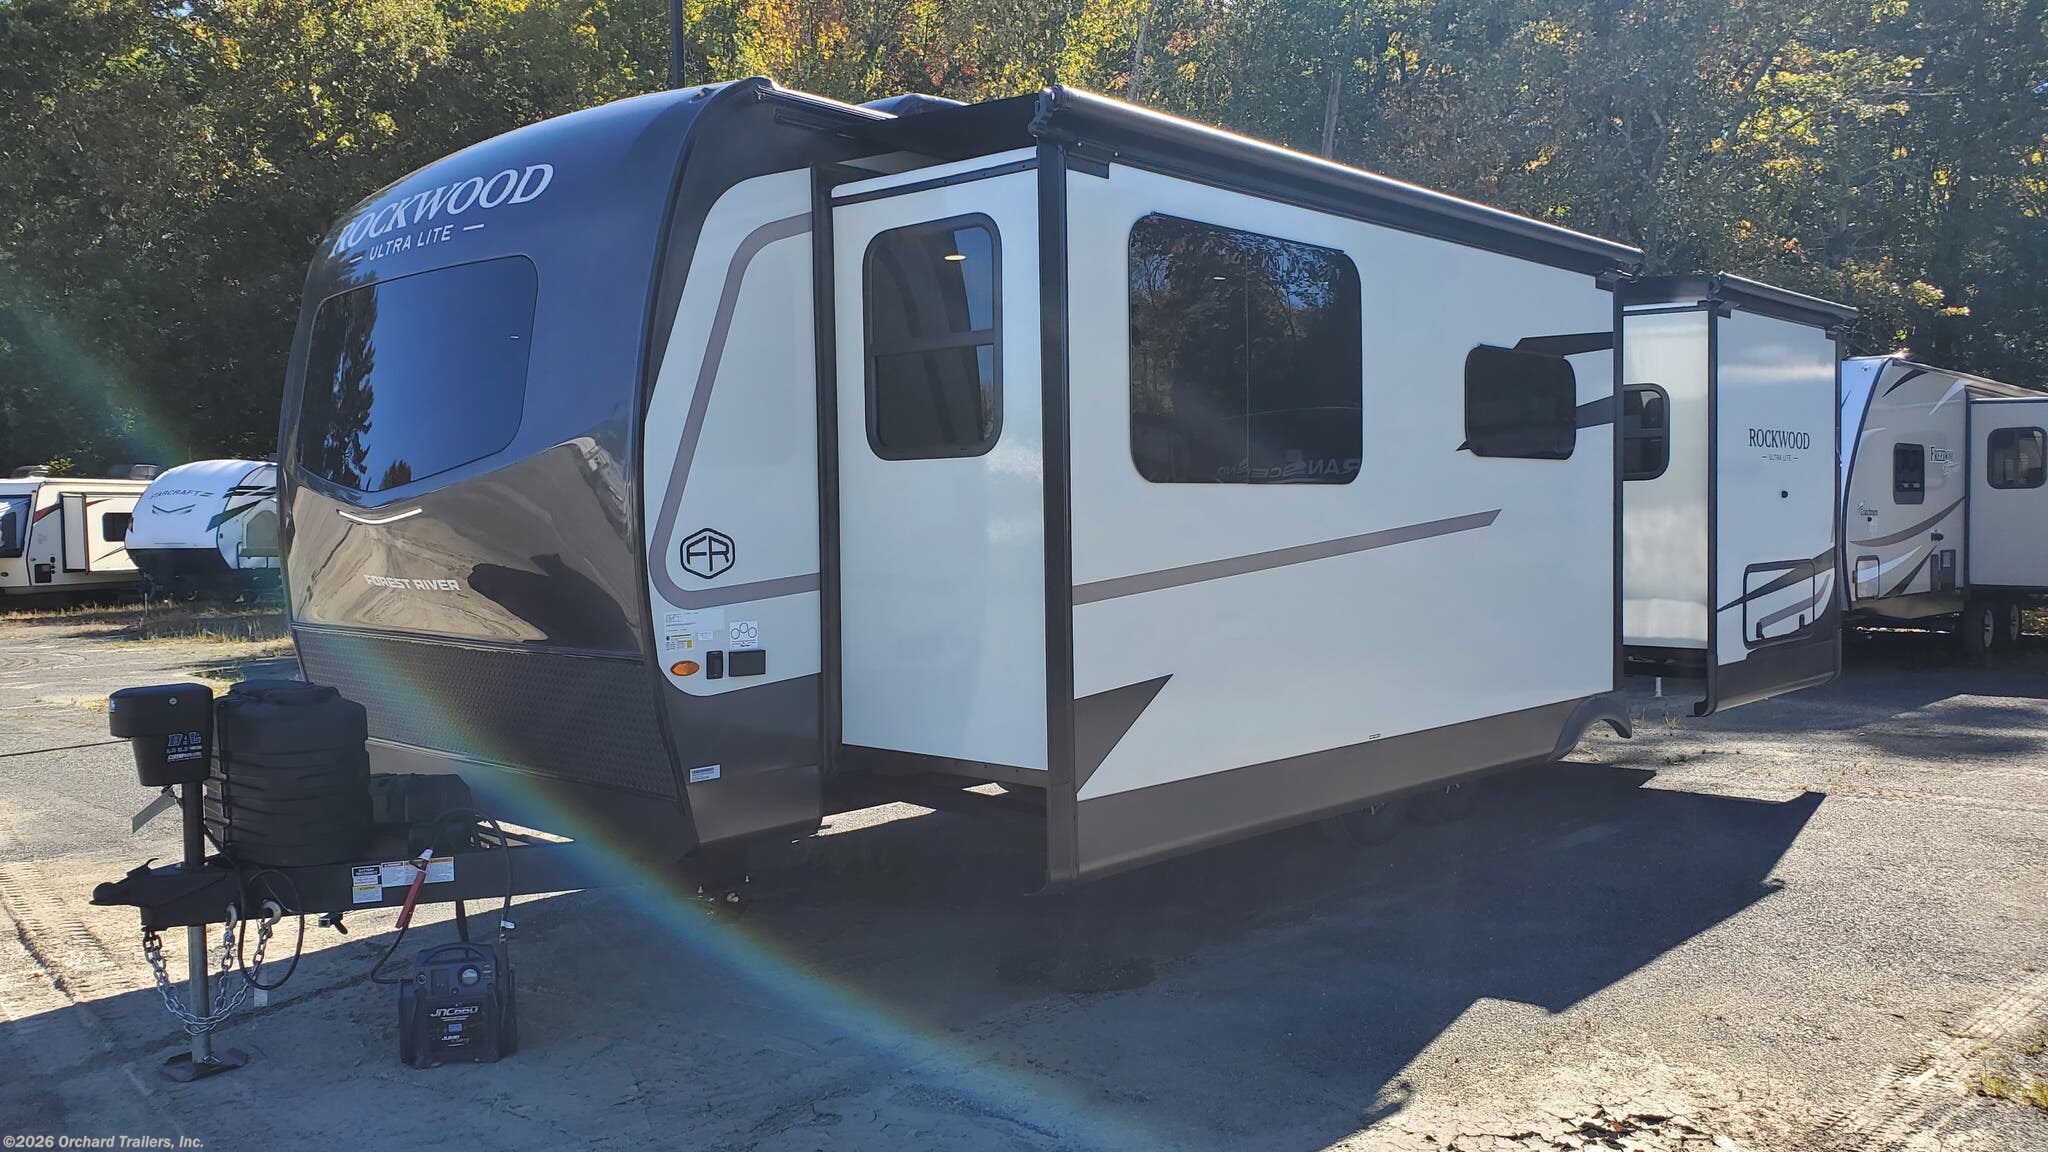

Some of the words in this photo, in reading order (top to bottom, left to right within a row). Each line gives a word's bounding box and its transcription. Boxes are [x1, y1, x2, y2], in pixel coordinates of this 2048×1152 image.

[328, 164, 554, 258] ROCKWOOD
[369, 235, 412, 261] ULTRA
[417, 224, 454, 248] LITE
[1749, 428, 1810, 450] ROCKWOOD
[364, 574, 411, 589] FOREST
[413, 578, 461, 591] RIVER
